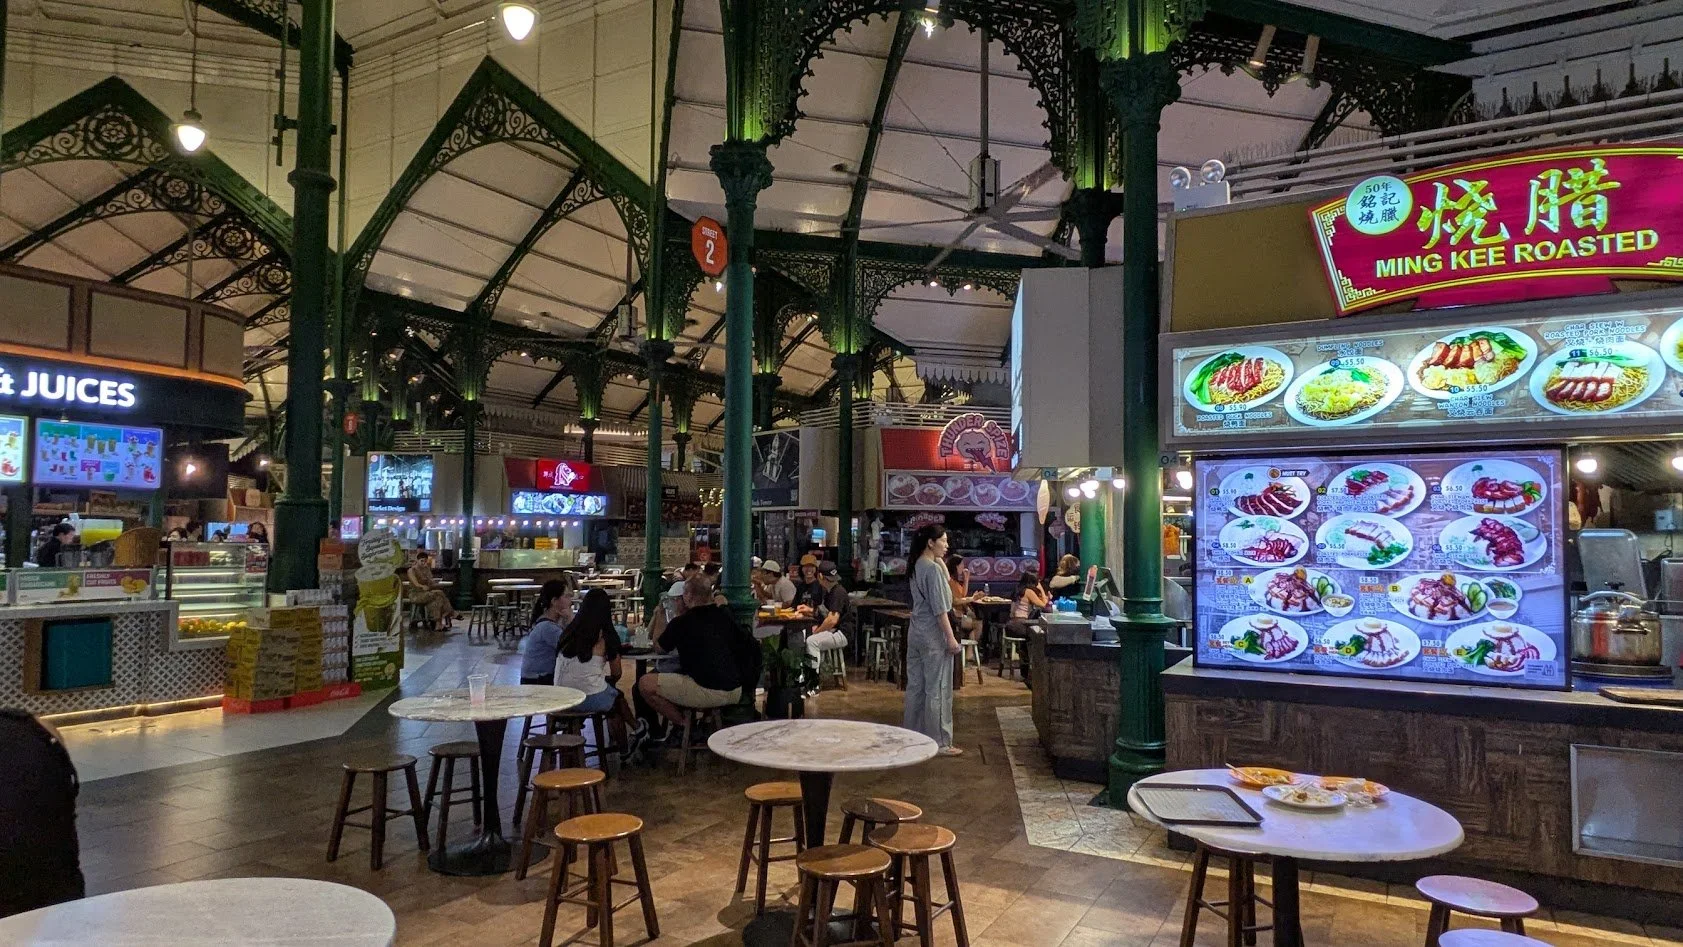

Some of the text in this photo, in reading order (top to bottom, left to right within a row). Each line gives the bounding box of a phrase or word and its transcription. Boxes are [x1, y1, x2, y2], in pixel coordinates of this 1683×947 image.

[1365, 181, 1392, 194] 50年
[1356, 192, 1401, 210] 銘記
[1416, 158, 1621, 249] 烧腊
[702, 226, 718, 240] STREET
[706, 239, 715, 265] 2
[1376, 229, 1659, 278] MING KEE ROASTED
[1545, 325, 1646, 339] ROASTED PORK NOODLES
[1565, 323, 1586, 331] CHAR
[1590, 320, 1612, 330] SIEW
[1317, 340, 1384, 351] DUMPLING NOODLES
[1589, 347, 1613, 357] $6.50
[1345, 358, 1365, 366] $5.50
[20, 371, 136, 408] JUICES
[1466, 385, 1488, 393] $5.50
[1229, 403, 1247, 411] $5.90
[1197, 413, 1224, 421] ROASTED
[1244, 411, 1273, 419] NOODLES
[940, 414, 1009, 458] THUNDER SPIZE
[388, 505, 406, 513] Design
